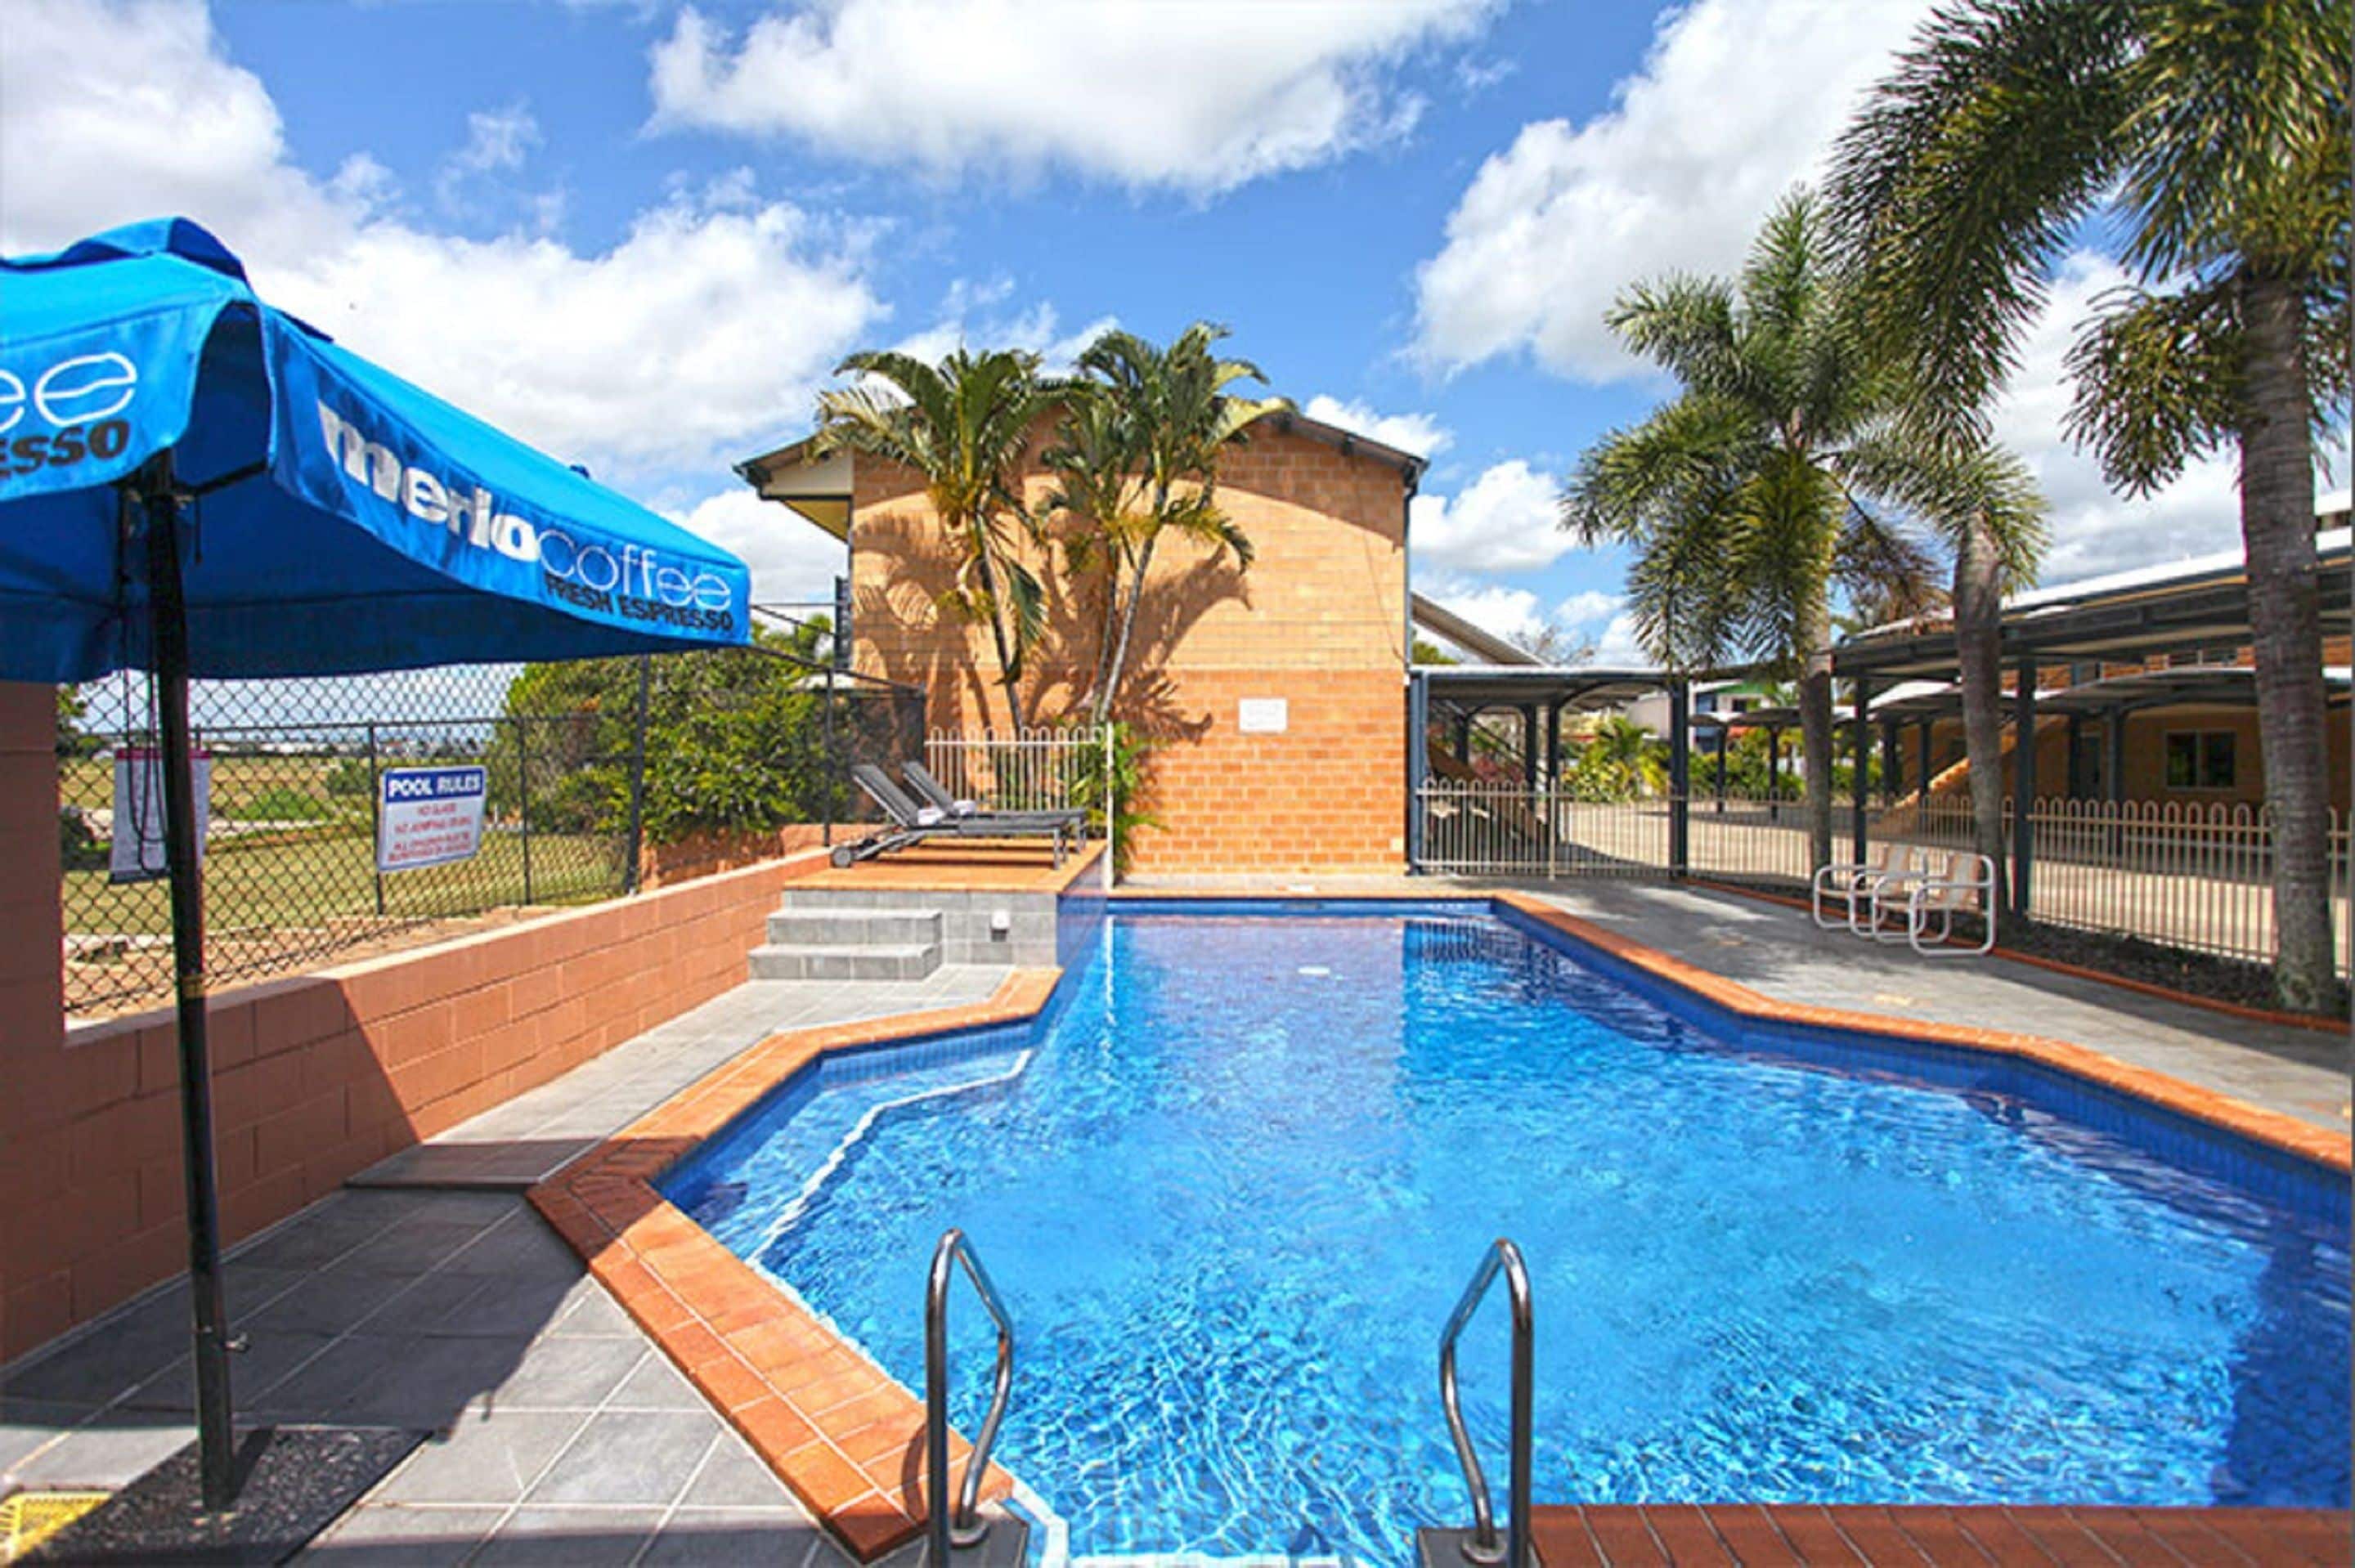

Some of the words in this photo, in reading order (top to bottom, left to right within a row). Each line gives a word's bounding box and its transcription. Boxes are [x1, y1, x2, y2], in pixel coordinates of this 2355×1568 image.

[0, 352, 137, 432] e
[545, 572, 614, 614] FRESH
[617, 595, 733, 631] ESPRESSO
[388, 777, 433, 798] POOL
[437, 773, 482, 795] RULES
